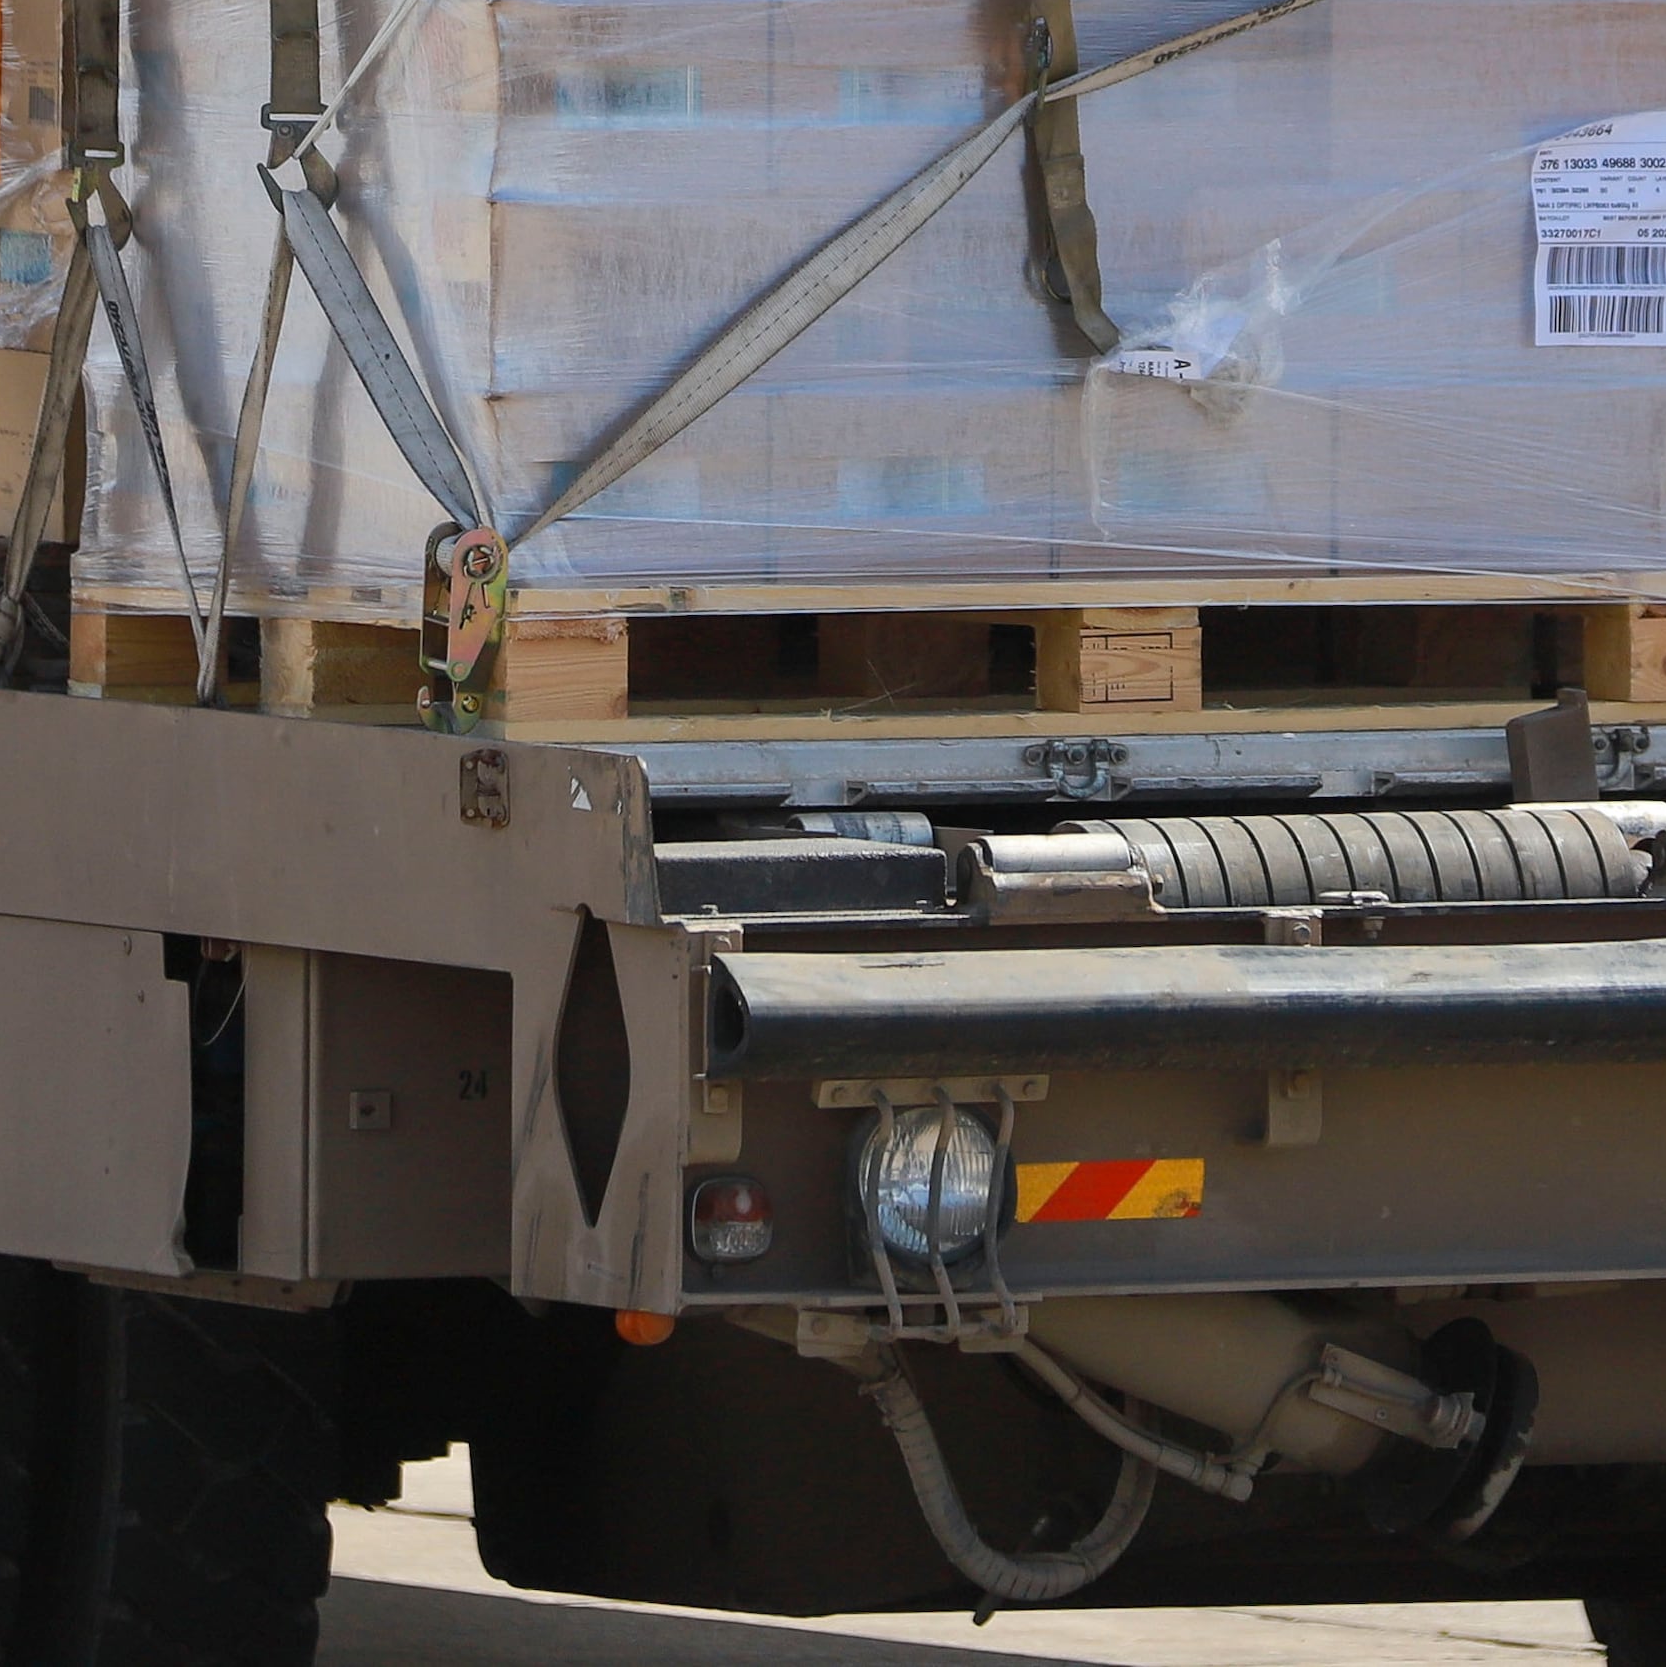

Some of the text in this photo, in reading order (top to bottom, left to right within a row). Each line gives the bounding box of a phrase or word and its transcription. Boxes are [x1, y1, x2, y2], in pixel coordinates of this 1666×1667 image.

[1539, 158, 1560, 170] 376
[1563, 158, 1598, 170] 13033
[1602, 157, 1637, 169] 49688
[458, 1070, 489, 1102] 24
